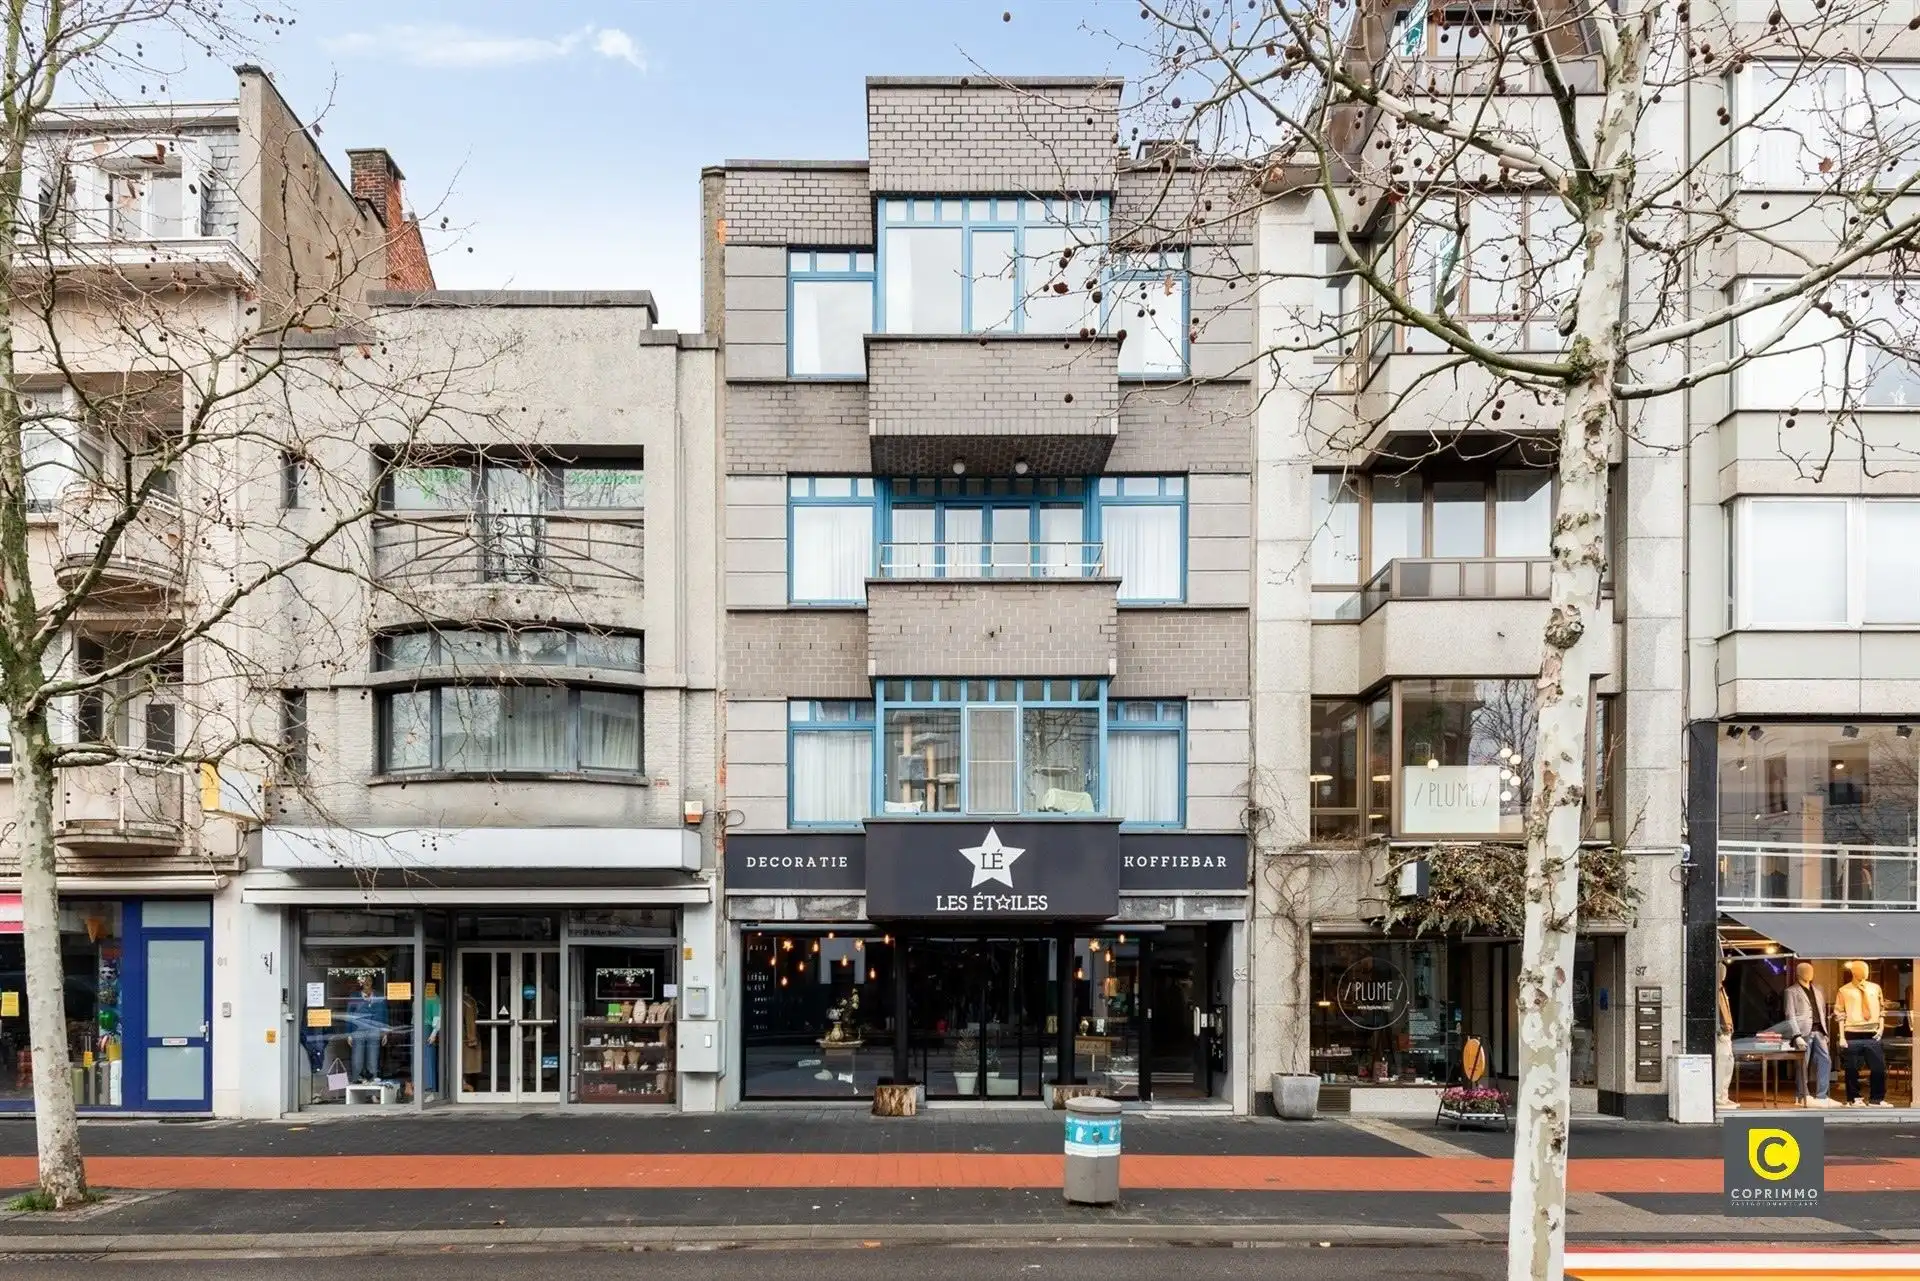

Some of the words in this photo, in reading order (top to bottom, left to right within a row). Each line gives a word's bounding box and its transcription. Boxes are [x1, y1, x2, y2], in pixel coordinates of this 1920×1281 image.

[746, 856, 848, 868] DECORATIE
[981, 848, 1004, 870] LÉ
[1123, 856, 1227, 868] KOFFIEBAR
[936, 895, 968, 911] LES
[1635, 965, 1648, 976] 87
